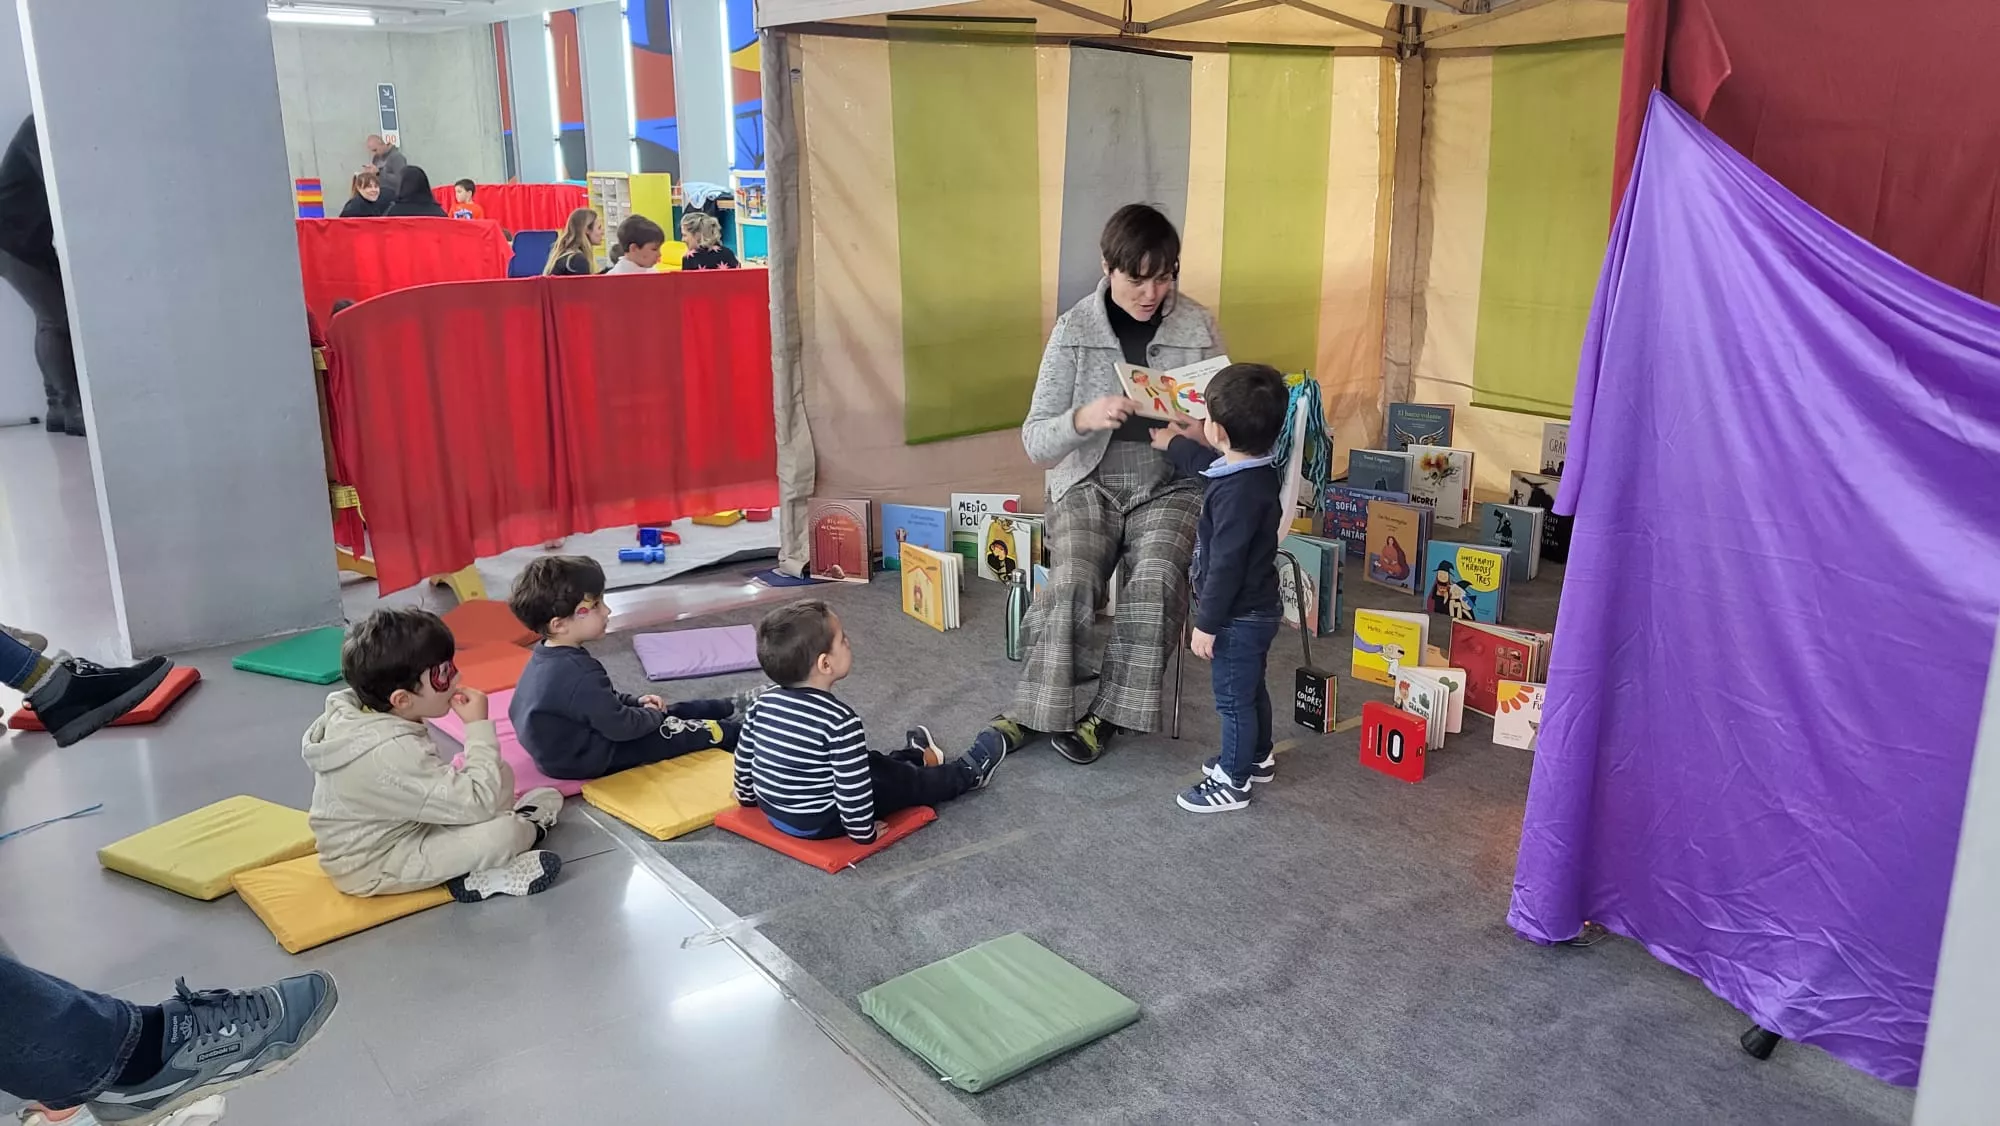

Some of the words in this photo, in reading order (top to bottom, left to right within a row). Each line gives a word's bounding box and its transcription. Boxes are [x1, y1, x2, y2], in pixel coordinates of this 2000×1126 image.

[1335, 499, 1357, 513] SOFÍA
[1341, 528, 1367, 541] ANTÁR
[1475, 573, 1492, 587] TRES
[1305, 684, 1316, 697] LOS
[1297, 690, 1323, 708] COLORES
[1375, 722, 1405, 764] 10
